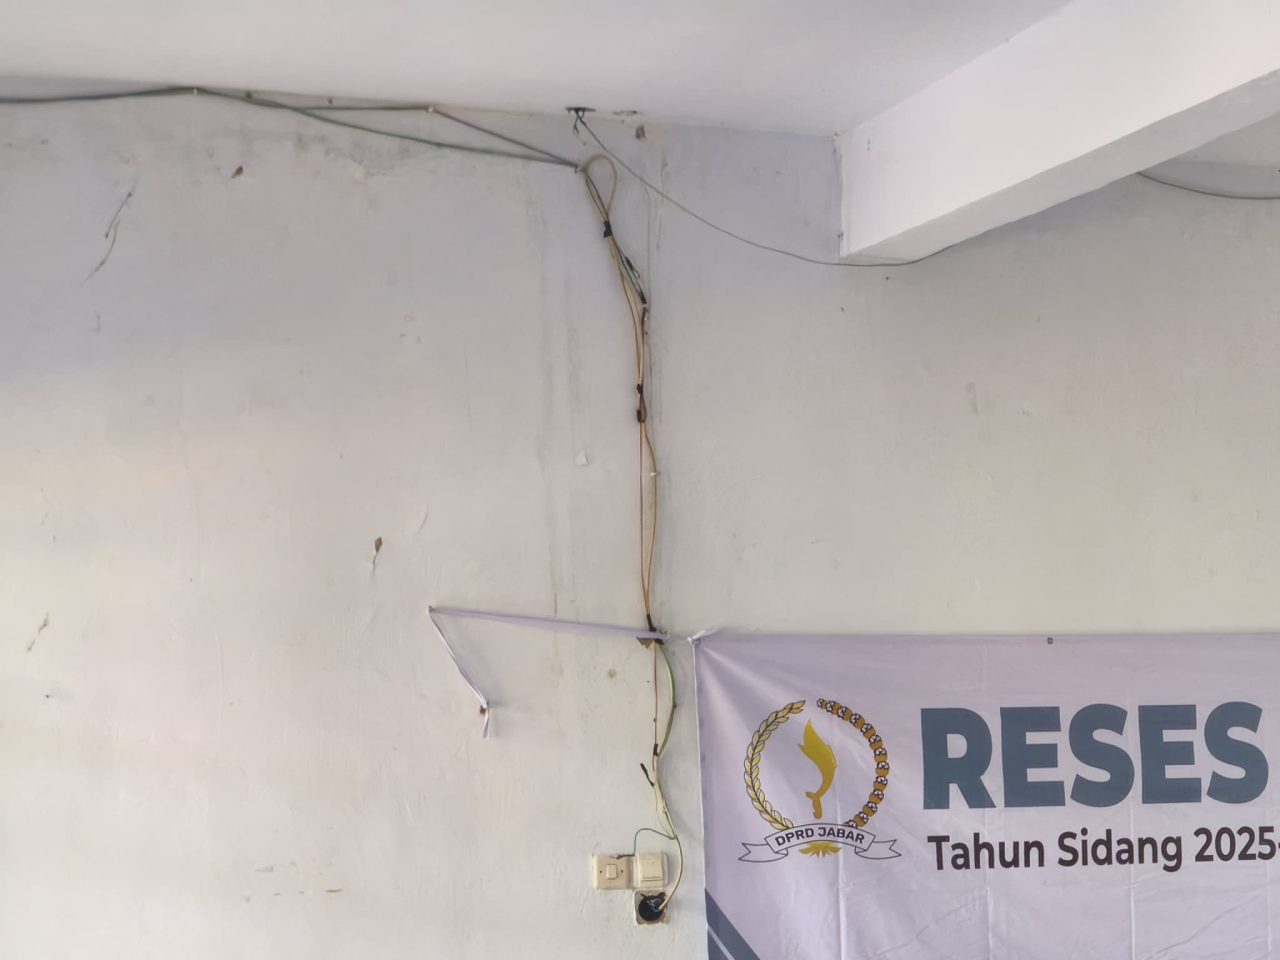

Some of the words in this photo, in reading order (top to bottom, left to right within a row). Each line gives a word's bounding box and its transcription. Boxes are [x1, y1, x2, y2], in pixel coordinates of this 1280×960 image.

[920, 701, 1269, 810] RESES
[775, 828, 815, 847] DPRD
[817, 826, 865, 844] JABAR
[927, 832, 1045, 871] Tahun
[1058, 827, 1183, 873] Sidang
